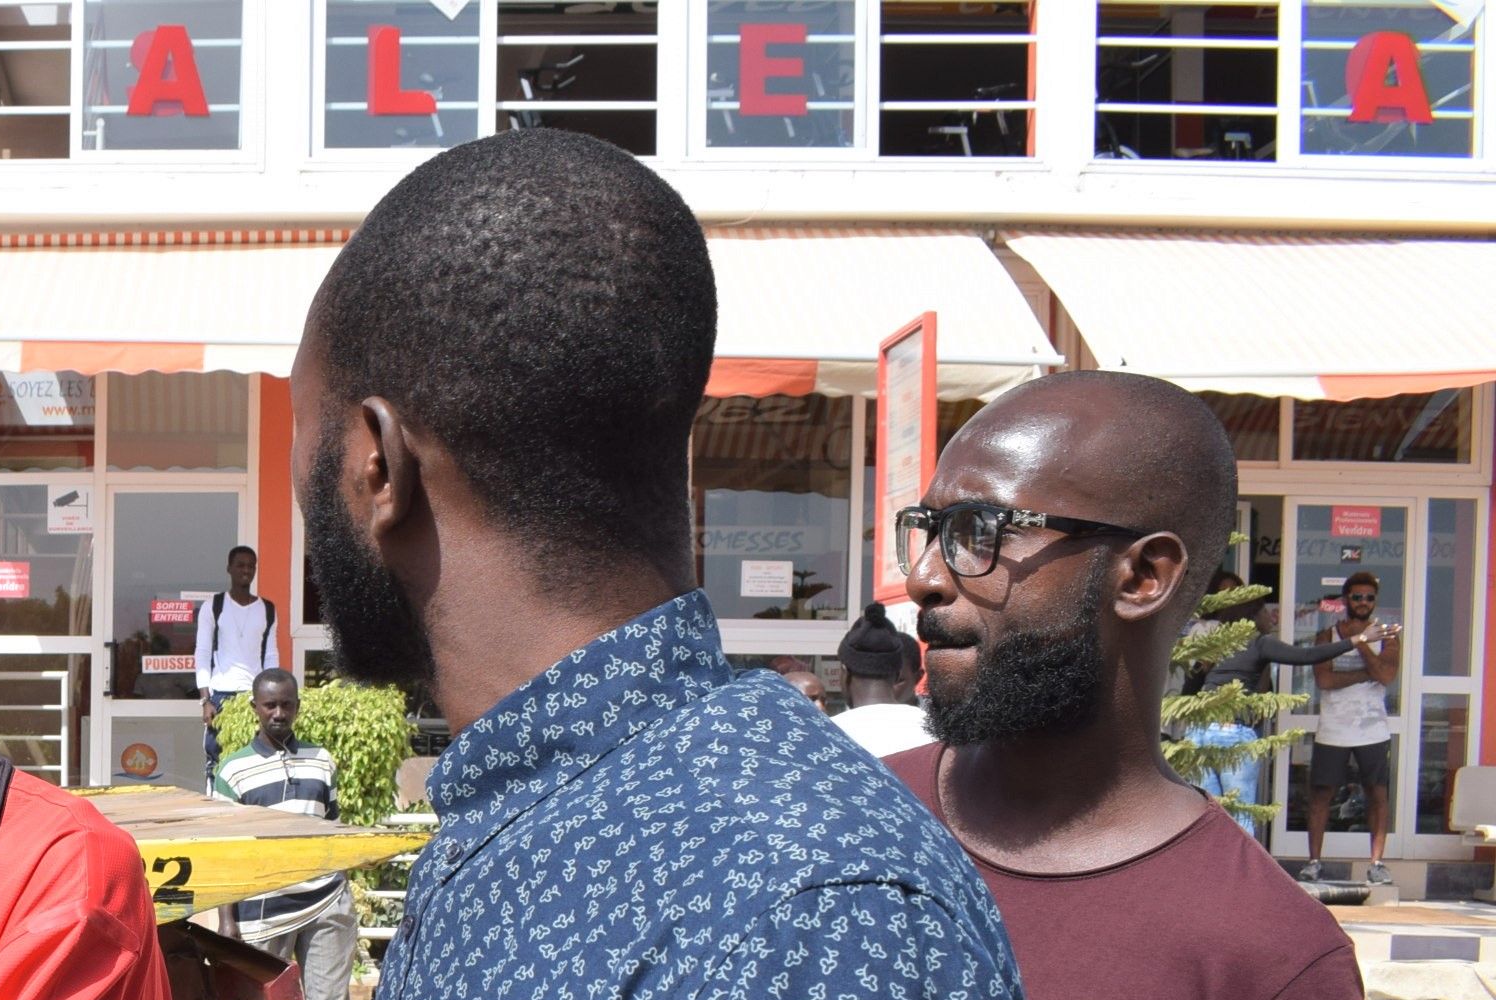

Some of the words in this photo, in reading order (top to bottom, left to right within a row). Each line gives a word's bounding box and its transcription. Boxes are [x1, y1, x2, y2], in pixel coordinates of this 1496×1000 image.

[126, 25, 210, 117] A
[368, 25, 437, 116] L
[739, 24, 807, 116] E
[1349, 32, 1434, 123] A
[156, 602, 189, 610] SORTIE
[145, 657, 196, 670] POUSSEZ
